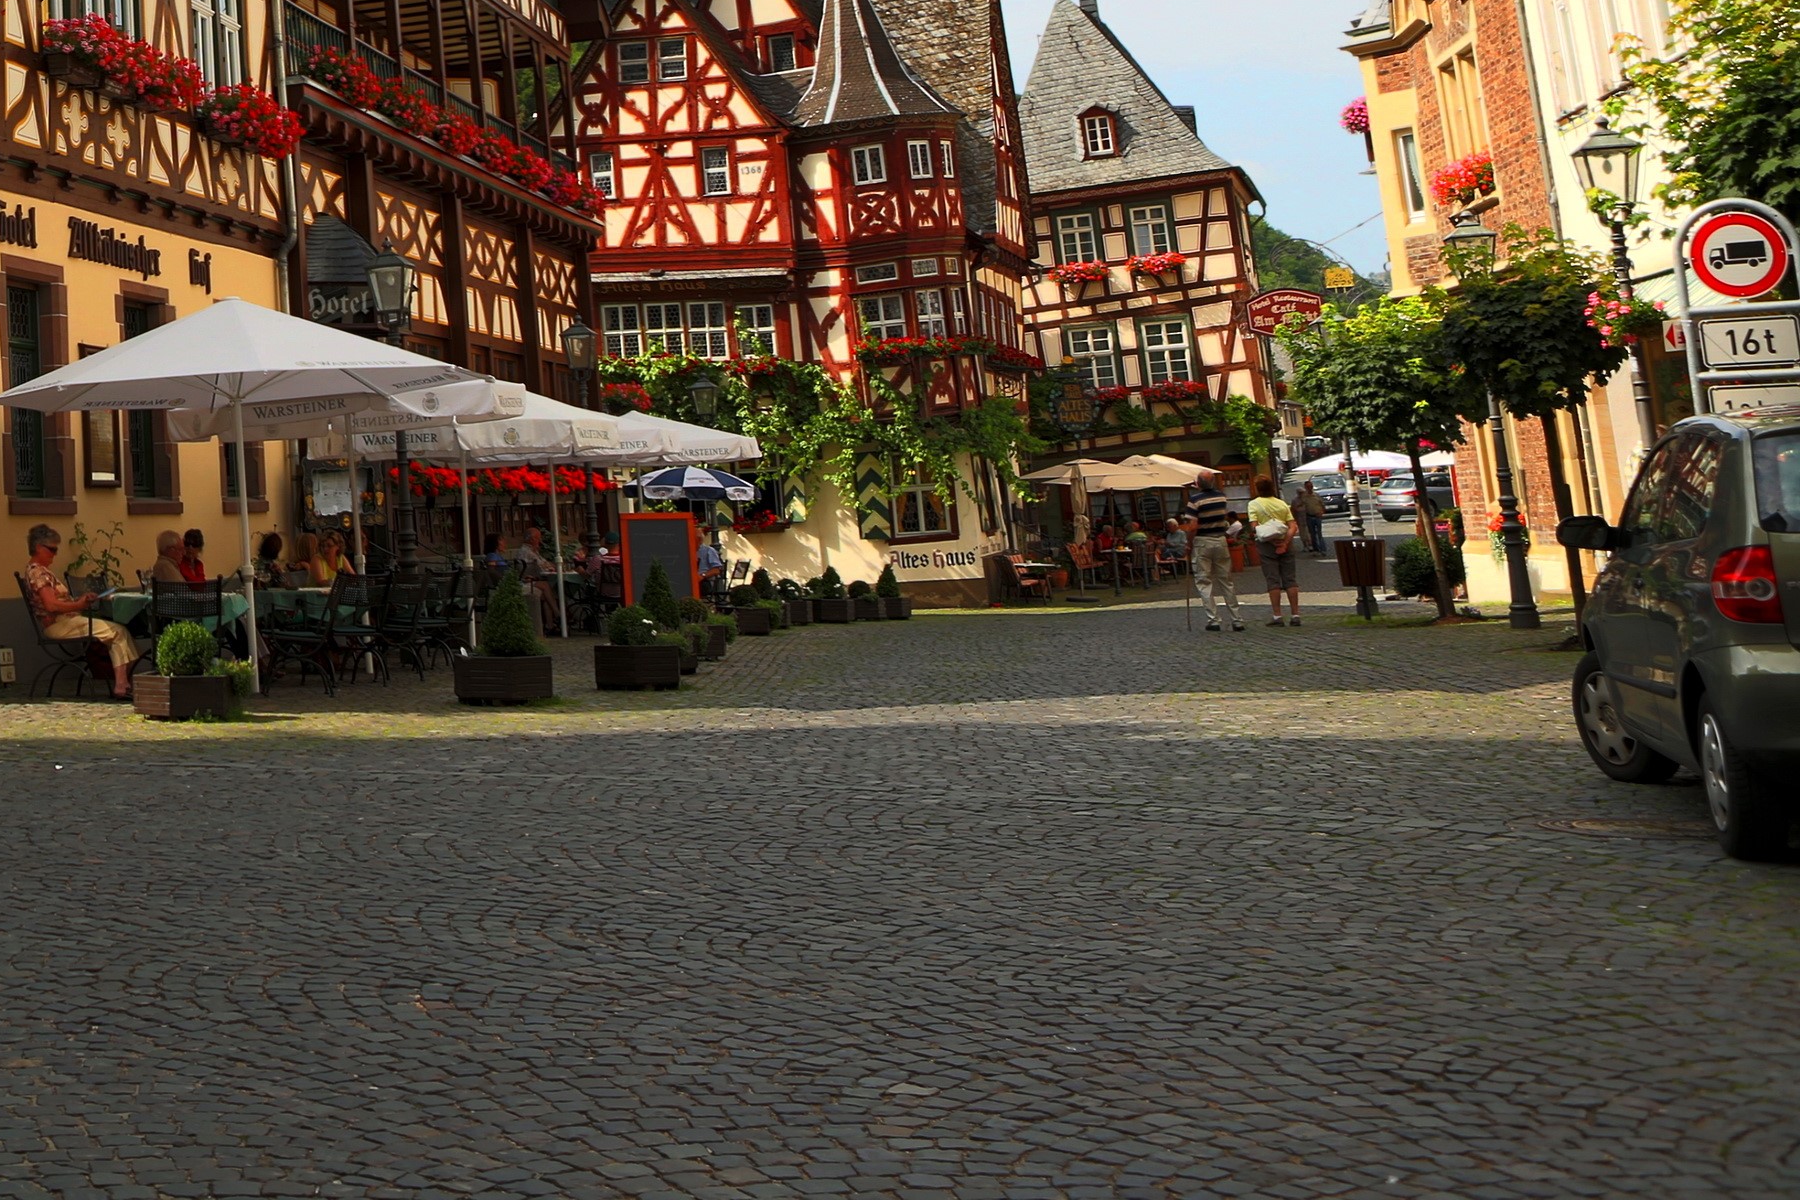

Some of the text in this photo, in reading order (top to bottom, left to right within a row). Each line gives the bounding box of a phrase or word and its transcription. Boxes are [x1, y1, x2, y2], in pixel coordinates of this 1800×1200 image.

[67, 216, 161, 281] Altkölnischer
[188, 247, 212, 295] Hof
[659, 281, 707, 292] Haus
[308, 288, 370, 319] Hotel
[1251, 294, 1318, 311] Hotel Restaurant
[1253, 315, 1275, 327] Am
[253, 398, 347, 420] WARSTEINER
[362, 433, 439, 446] WARSEINER
[890, 550, 930, 570] Altes
